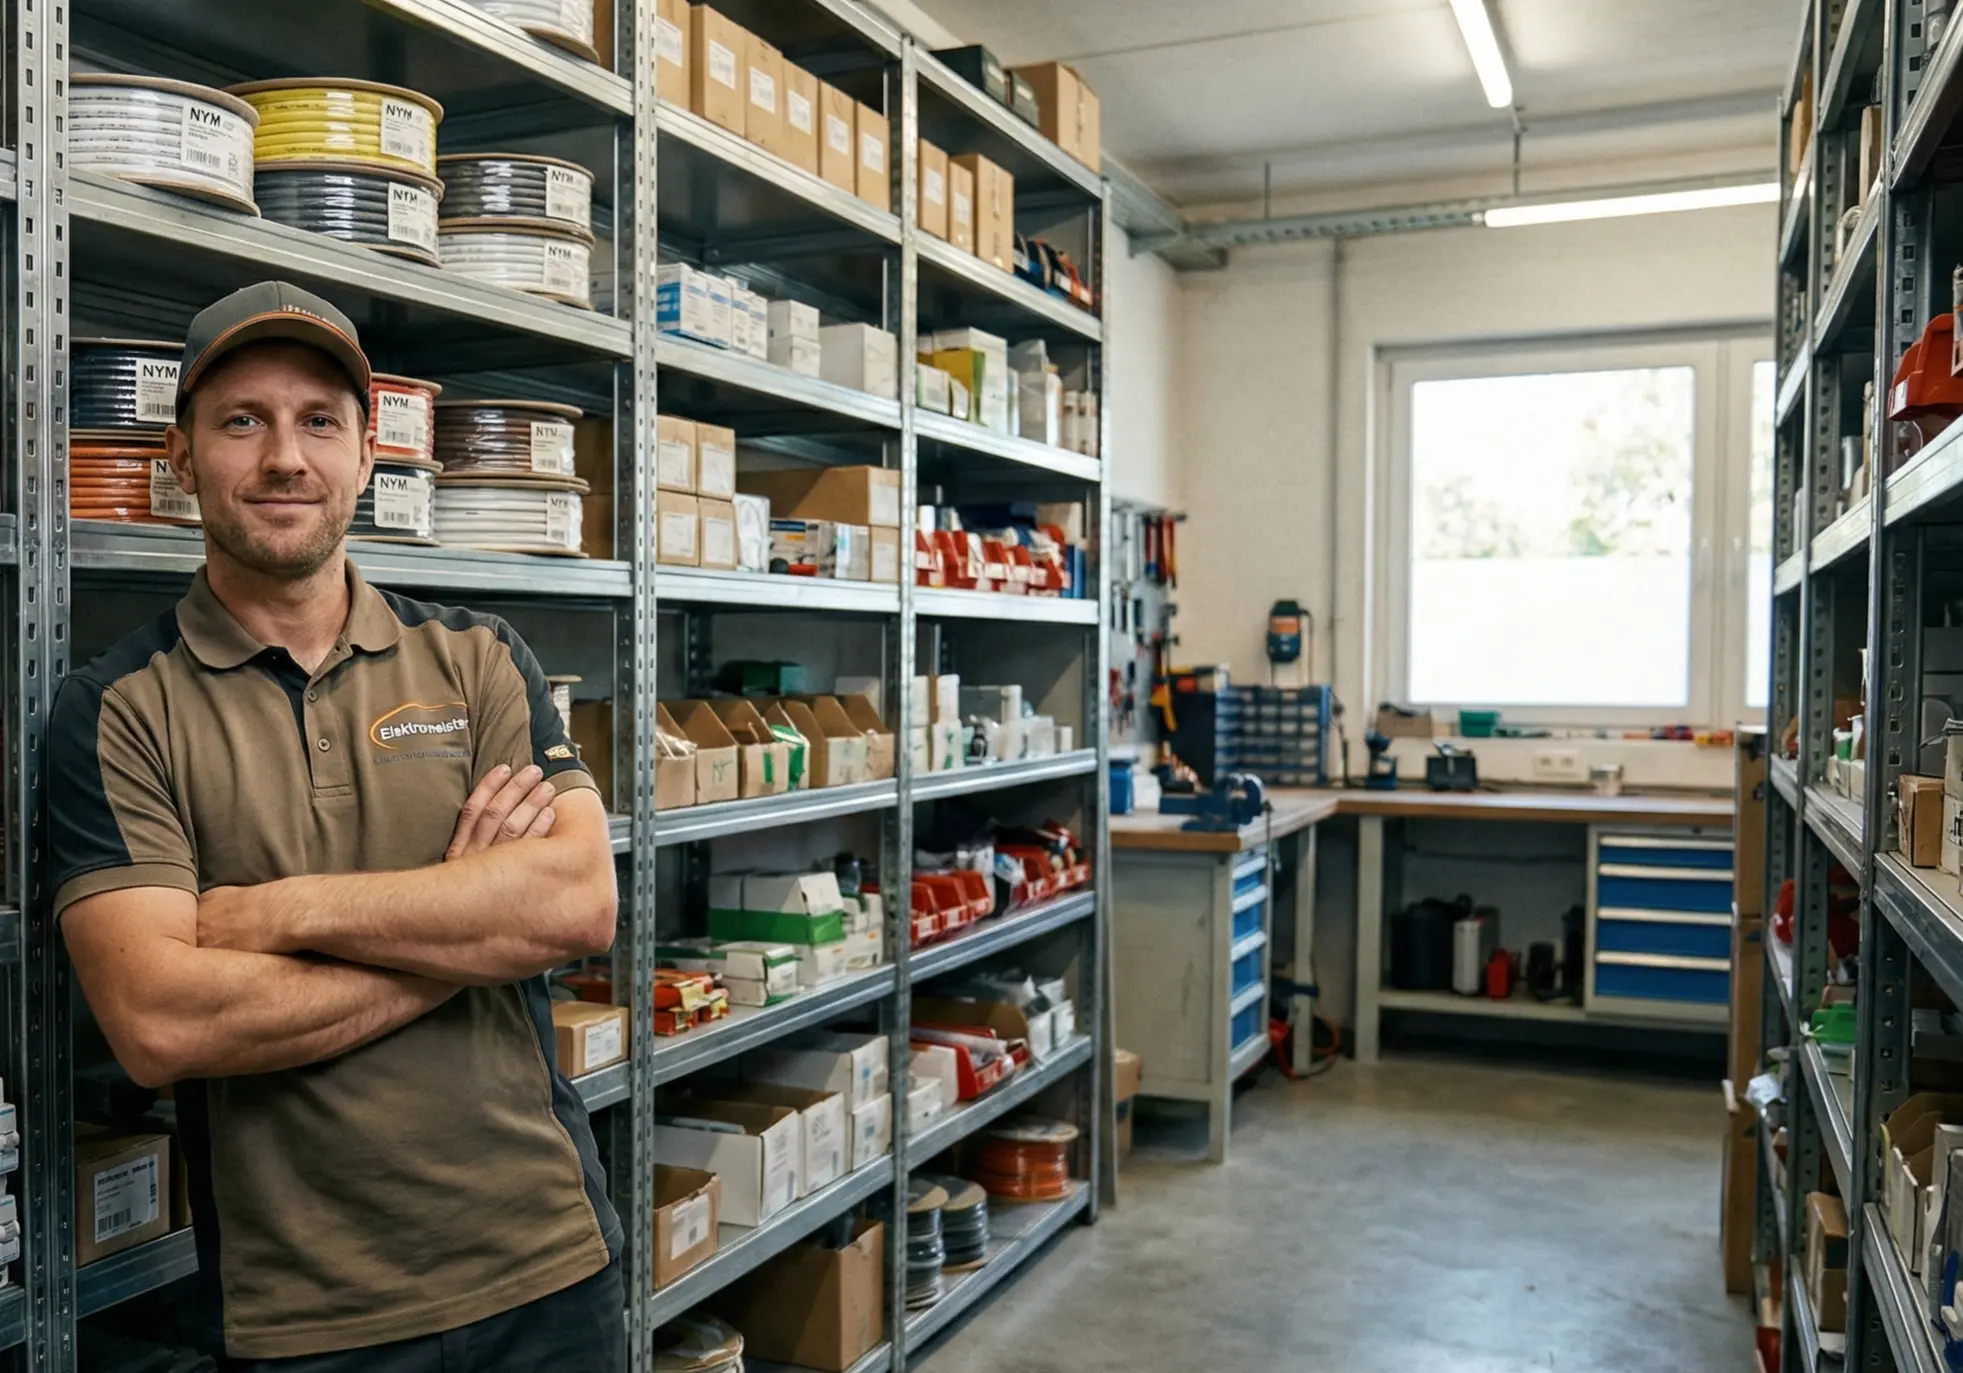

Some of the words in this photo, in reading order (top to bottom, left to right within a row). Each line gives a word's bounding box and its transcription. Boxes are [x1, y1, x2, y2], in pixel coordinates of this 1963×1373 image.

[190, 107, 221, 127] NYM
[143, 364, 177, 379] NYM
[383, 395, 409, 408] NYM
[380, 477, 407, 491] NYM
